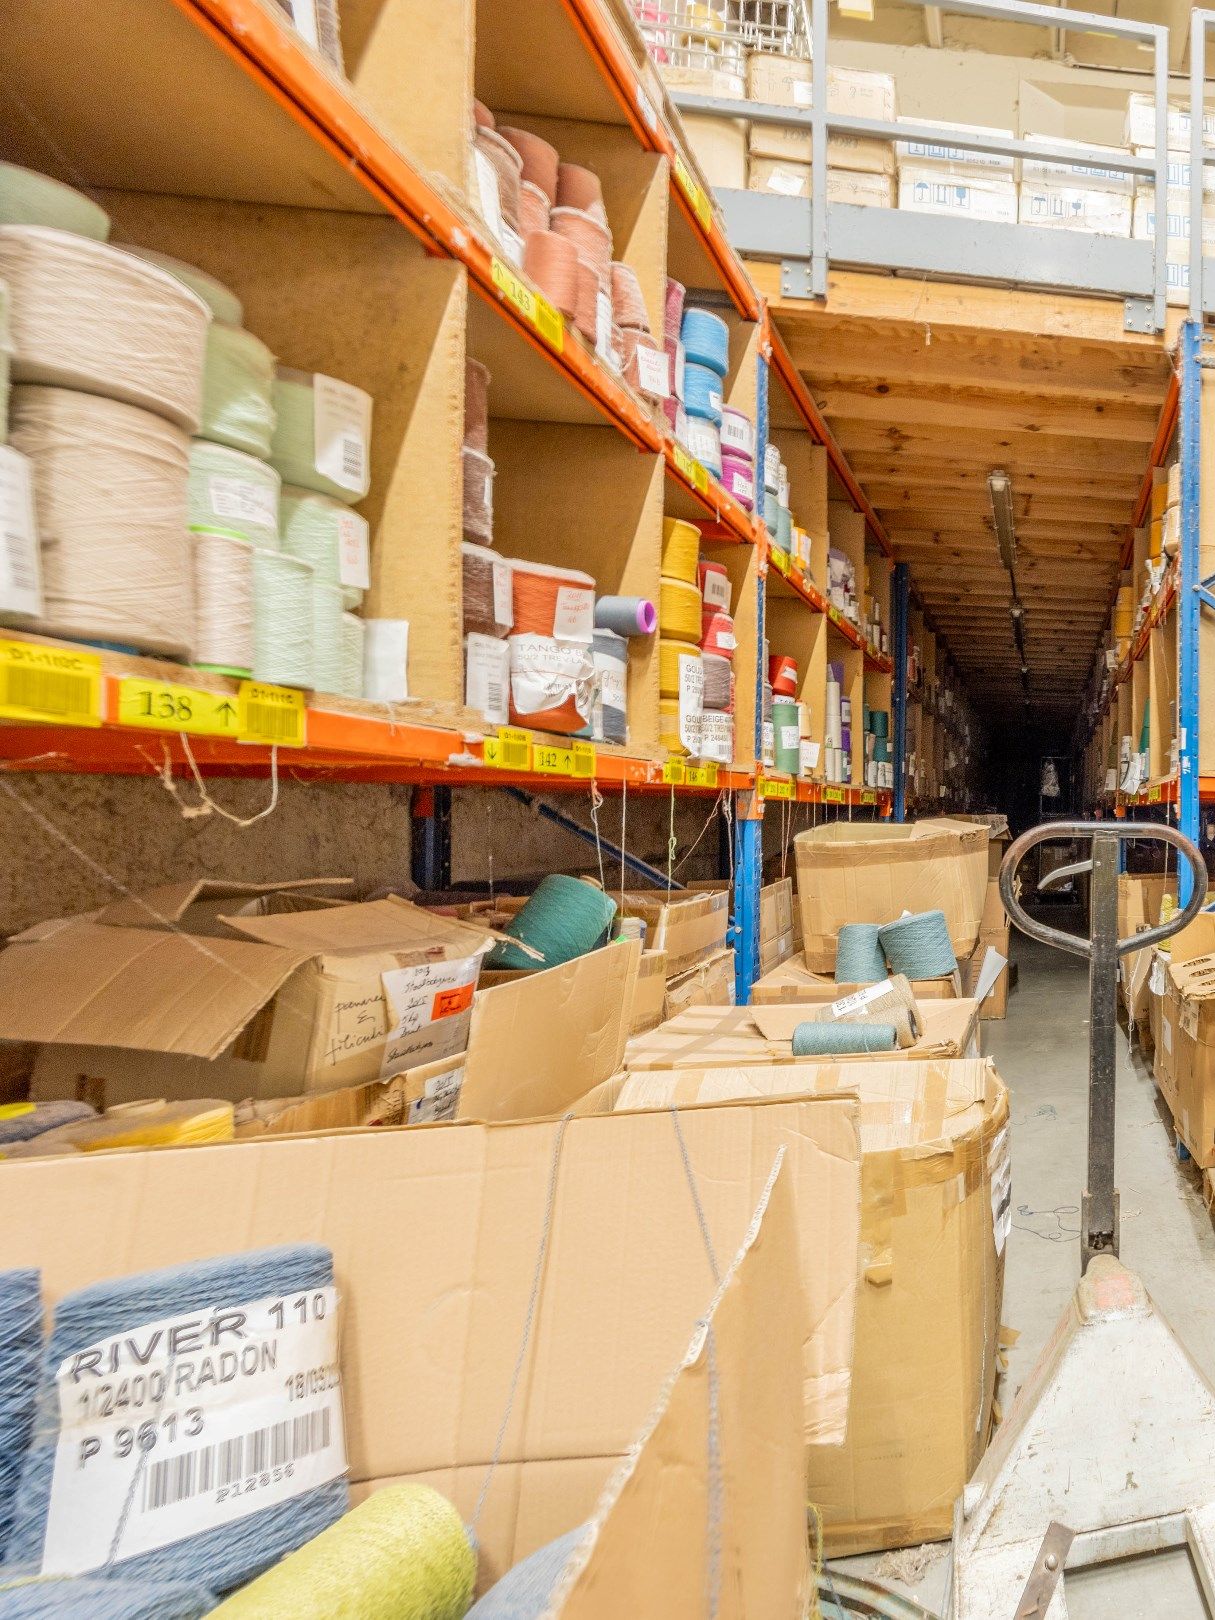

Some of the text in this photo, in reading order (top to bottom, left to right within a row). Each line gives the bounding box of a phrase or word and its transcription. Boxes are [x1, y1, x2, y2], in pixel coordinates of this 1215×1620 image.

[519, 641, 572, 656] TANGO
[138, 691, 193, 723] 138
[703, 714, 724, 723] BEIGE
[540, 751, 558, 768] 142
[70, 1292, 327, 1385] RIVER 110
[174, 1338, 278, 1398] RADON
[77, 1434, 103, 1473] P
[112, 1405, 205, 1460] 9613
